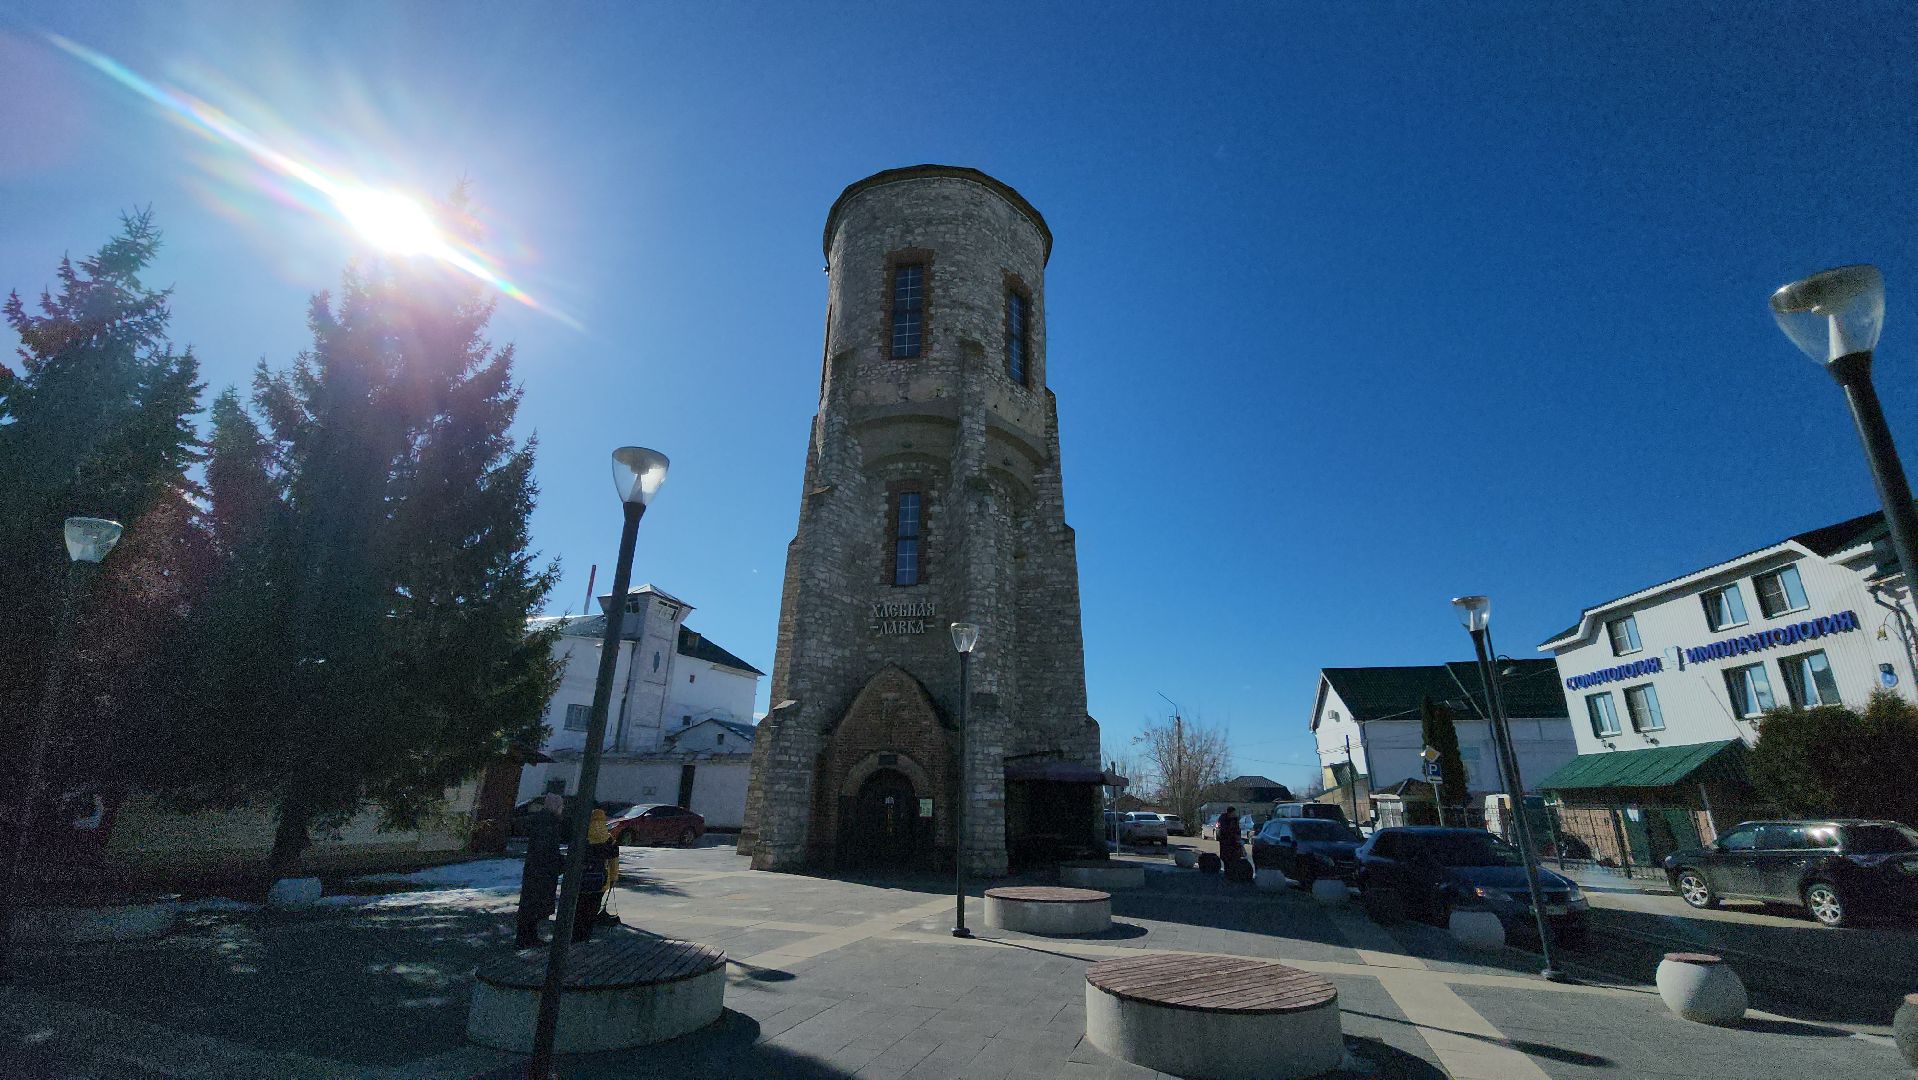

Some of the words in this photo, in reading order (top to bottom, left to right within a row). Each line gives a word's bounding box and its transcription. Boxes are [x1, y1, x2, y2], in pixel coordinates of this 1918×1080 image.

[871, 601, 936, 618] ХЛЕБНАЯ
[880, 619, 925, 635] ЛАВКА
[1566, 657, 1661, 690] СТОМАТОЛОГИЯ
[1685, 610, 1857, 664] ИМПЛАНТОЛОГИЯ
